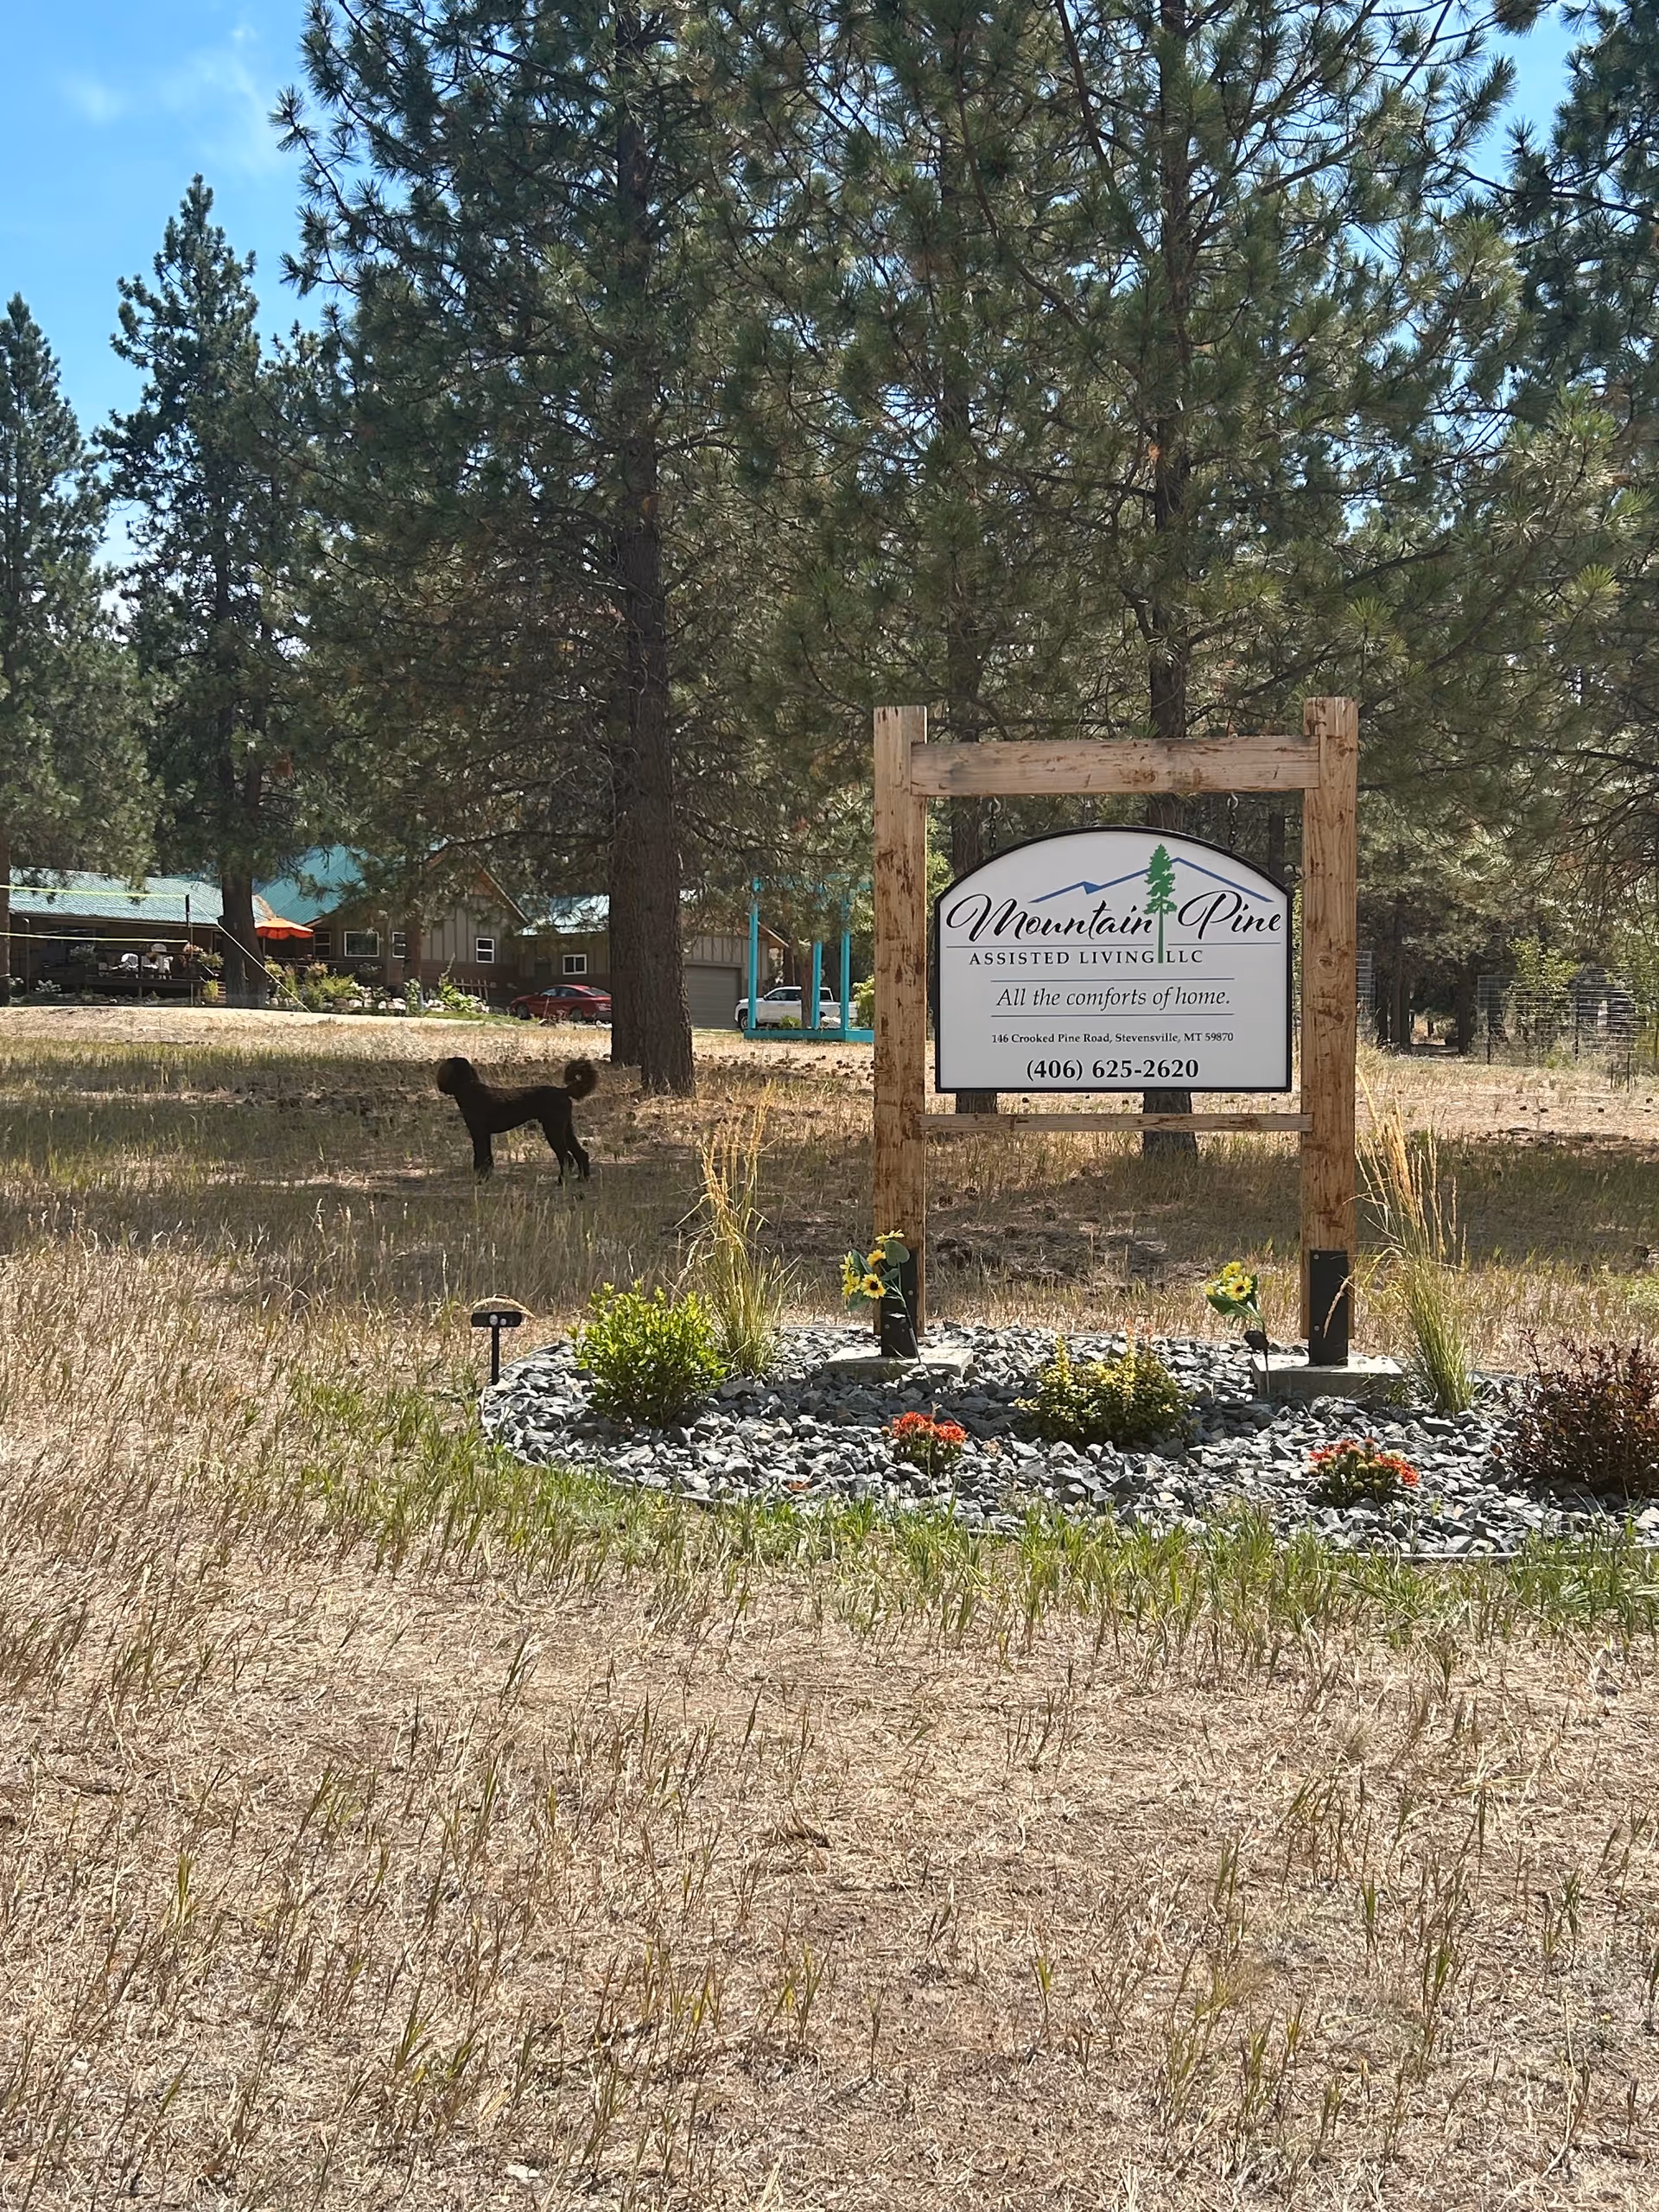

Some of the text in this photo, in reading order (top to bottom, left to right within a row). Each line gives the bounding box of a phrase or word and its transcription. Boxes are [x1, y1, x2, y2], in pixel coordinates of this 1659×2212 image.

[945, 889, 1281, 942] Mountain Pine
[969, 950, 1203, 966] ASSISTED LIVING LLC
[995, 986, 1230, 1012] All the comforts of home.
[991, 1032, 1234, 1044] 146 Crooked Pine Road, Stevensville, MT 59870
[1027, 1058, 1199, 1082] (406) 625-2620
